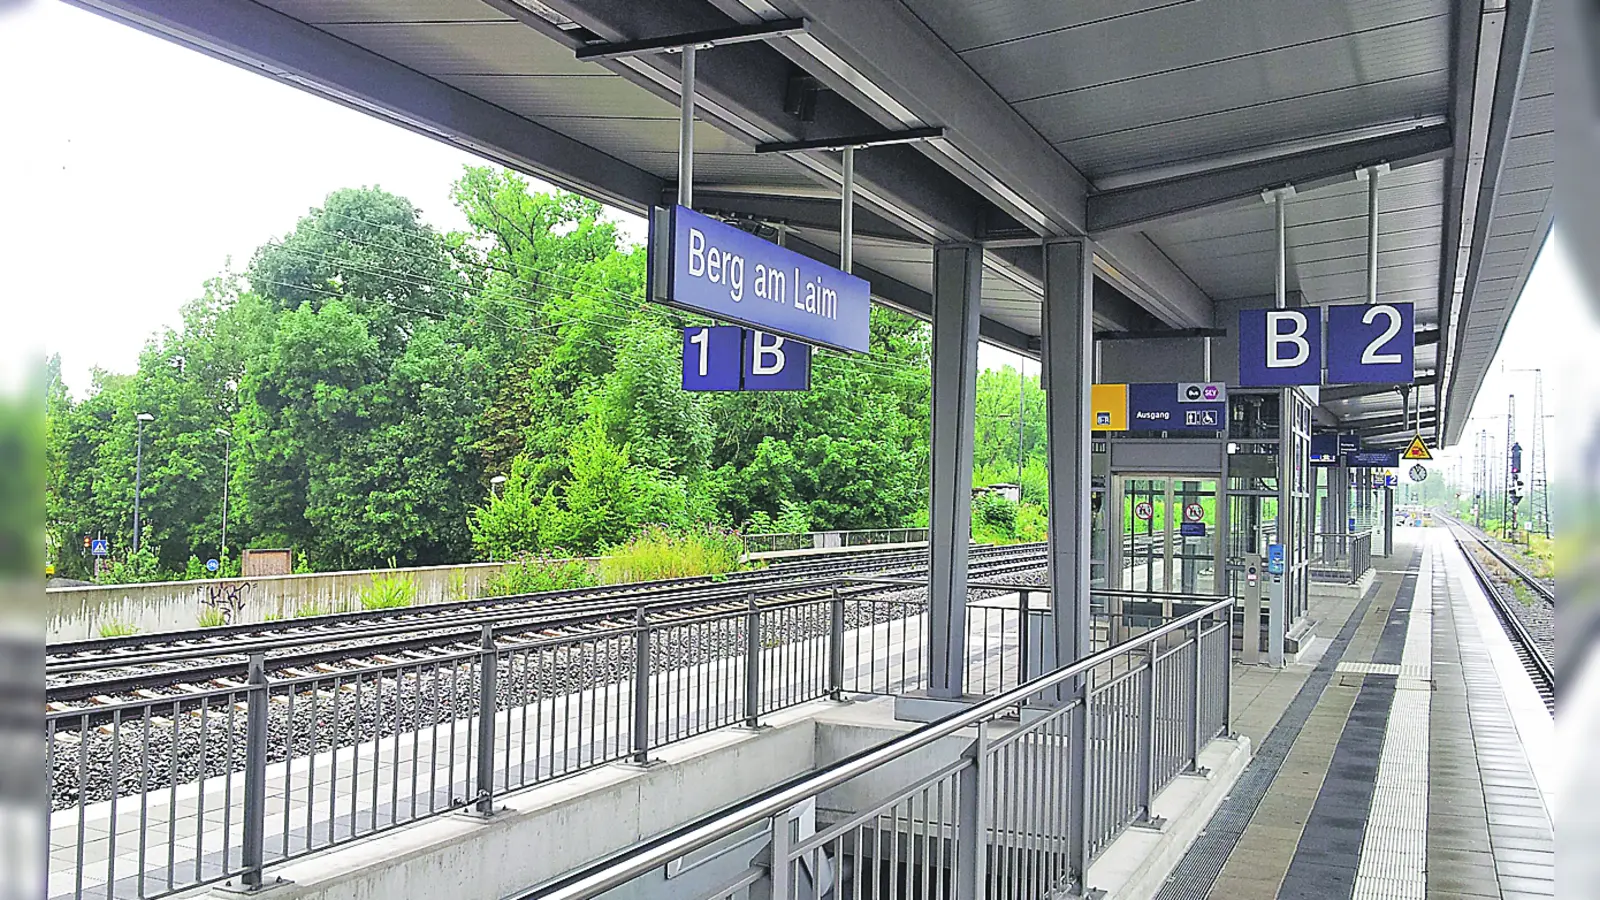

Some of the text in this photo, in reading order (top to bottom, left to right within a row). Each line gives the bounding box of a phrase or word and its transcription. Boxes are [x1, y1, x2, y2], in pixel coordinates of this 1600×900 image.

[688, 227, 837, 320] Berg am Laim
[690, 328, 785, 376] 1 B
[1266, 304, 1402, 368] B 2
[1136, 411, 1170, 420] Ausgang
